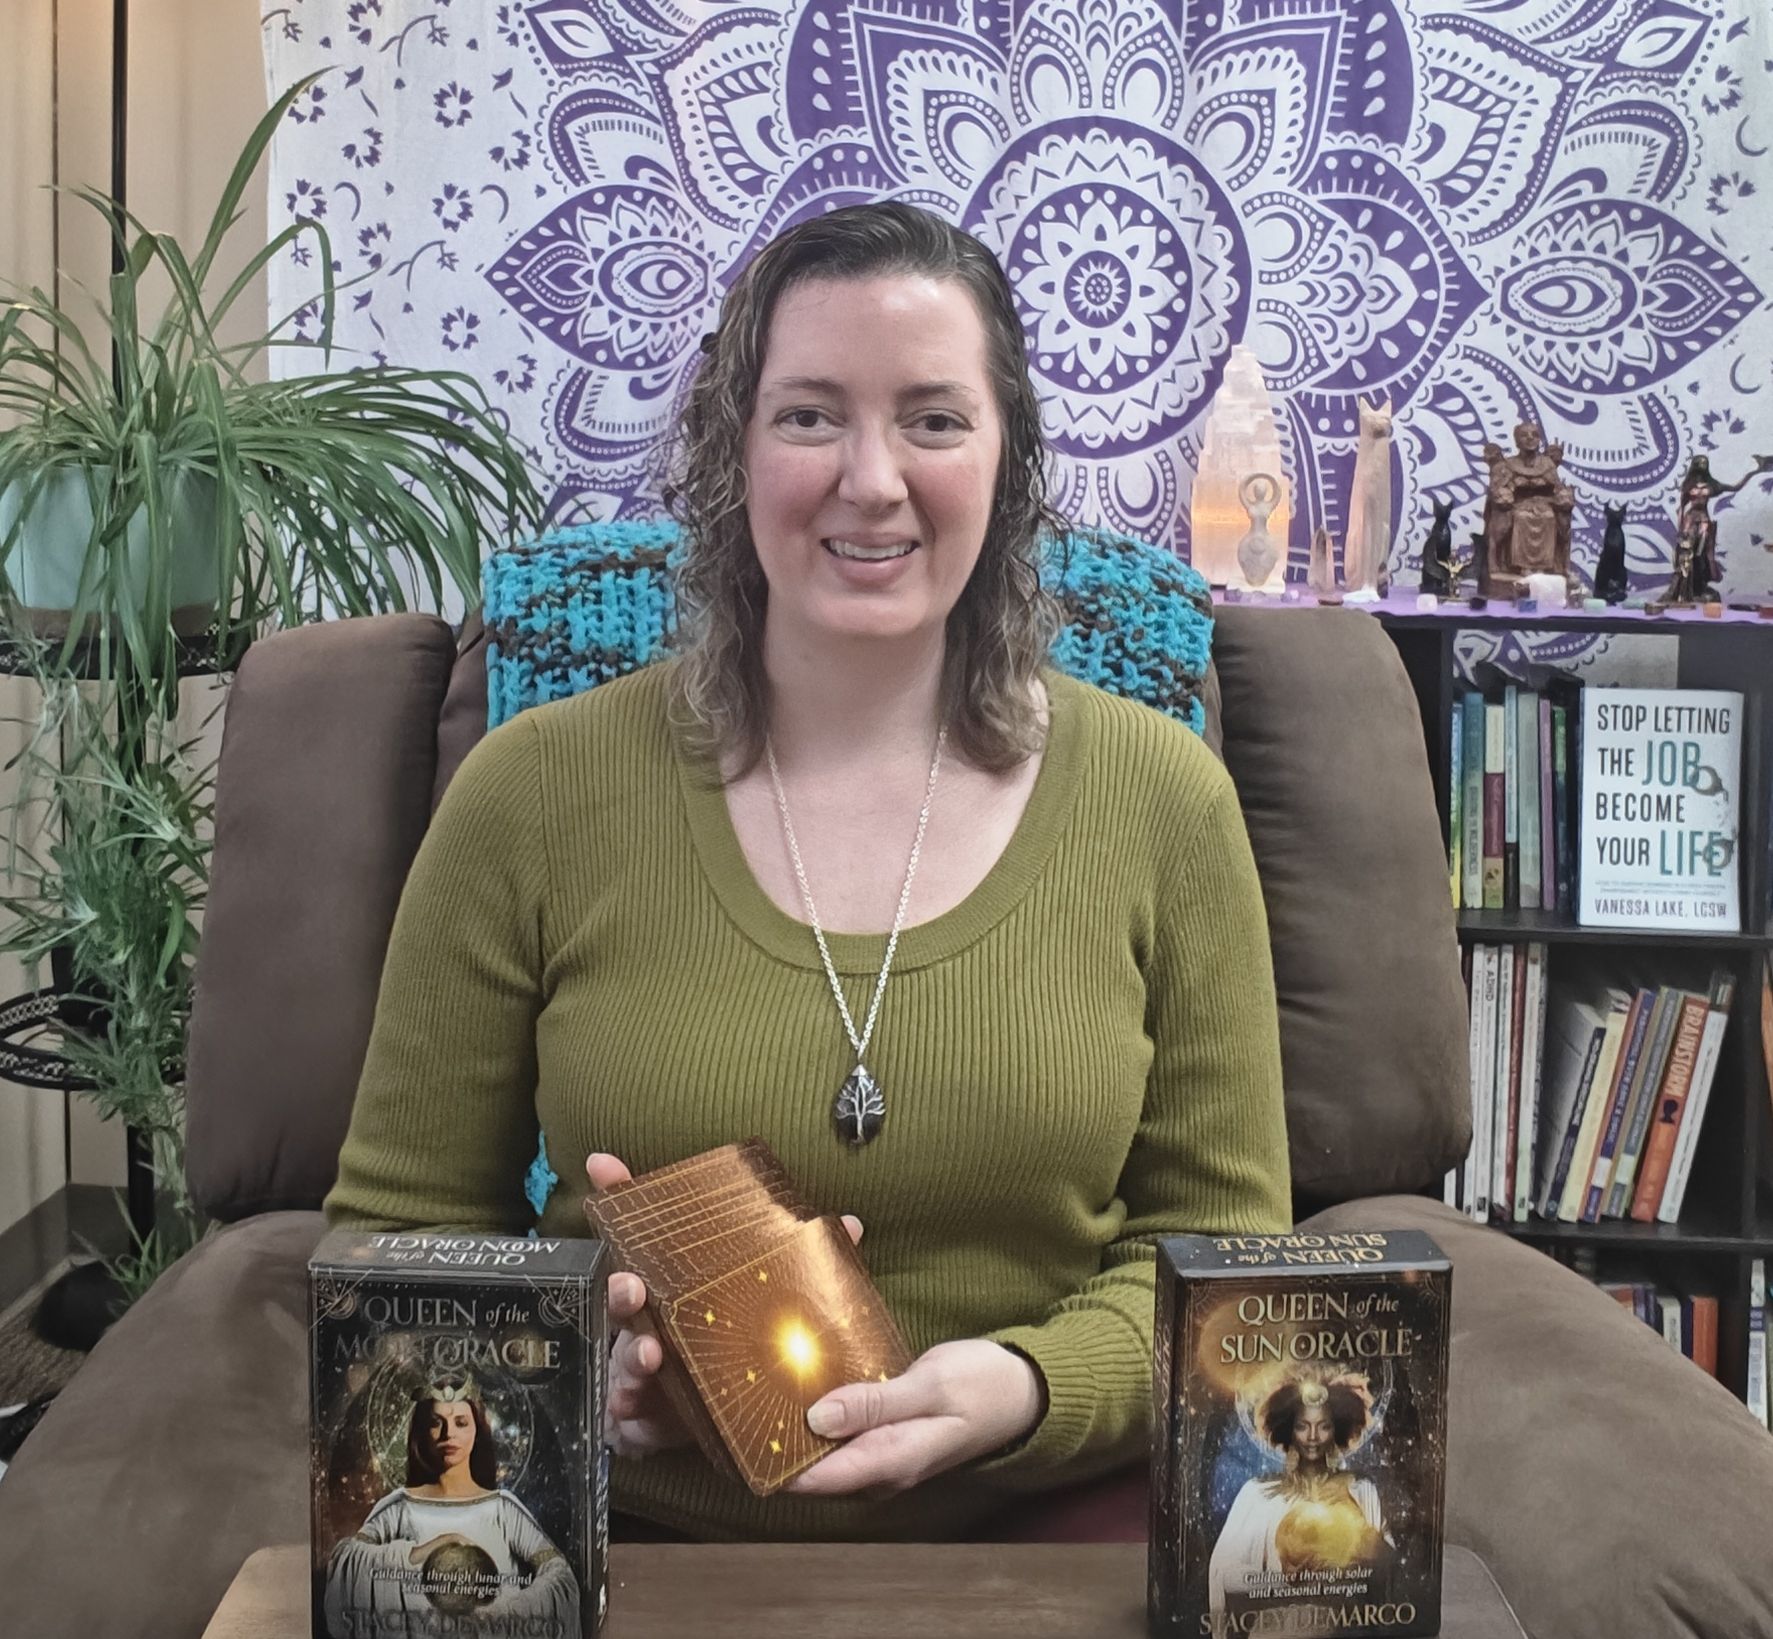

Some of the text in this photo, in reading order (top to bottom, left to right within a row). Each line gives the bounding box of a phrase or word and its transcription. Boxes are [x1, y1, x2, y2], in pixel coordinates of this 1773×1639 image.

[1597, 704, 1730, 735] STOP LETTING
[1597, 740, 1701, 787] THE JOB
[1595, 792, 1685, 823] BECOME
[1596, 829, 1722, 876] YOUR LIFE
[1594, 899, 1650, 916] VANESSA
[1694, 902, 1727, 918] LCSW
[1663, 1004, 1705, 1098] BRAINSTORM
[370, 1236, 561, 1254] MOON ORACLE
[1213, 1233, 1388, 1251] SUN ORACLE
[386, 1250, 526, 1266] QUEEN of the
[1237, 1248, 1384, 1265] QUEEN of the
[364, 1296, 530, 1327] QUEEN of the
[1238, 1291, 1400, 1326] QUEEN of the
[335, 1333, 561, 1369] MO ORACLE
[1220, 1328, 1413, 1364] SUN ORACLE
[369, 1567, 533, 1585] Guidance through lunar and
[1244, 1567, 1374, 1585] Guidance through solar
[402, 1582, 500, 1598] seasonal energies
[1249, 1583, 1368, 1599] and seasonal energies
[1200, 1609, 1284, 1634] STACEY
